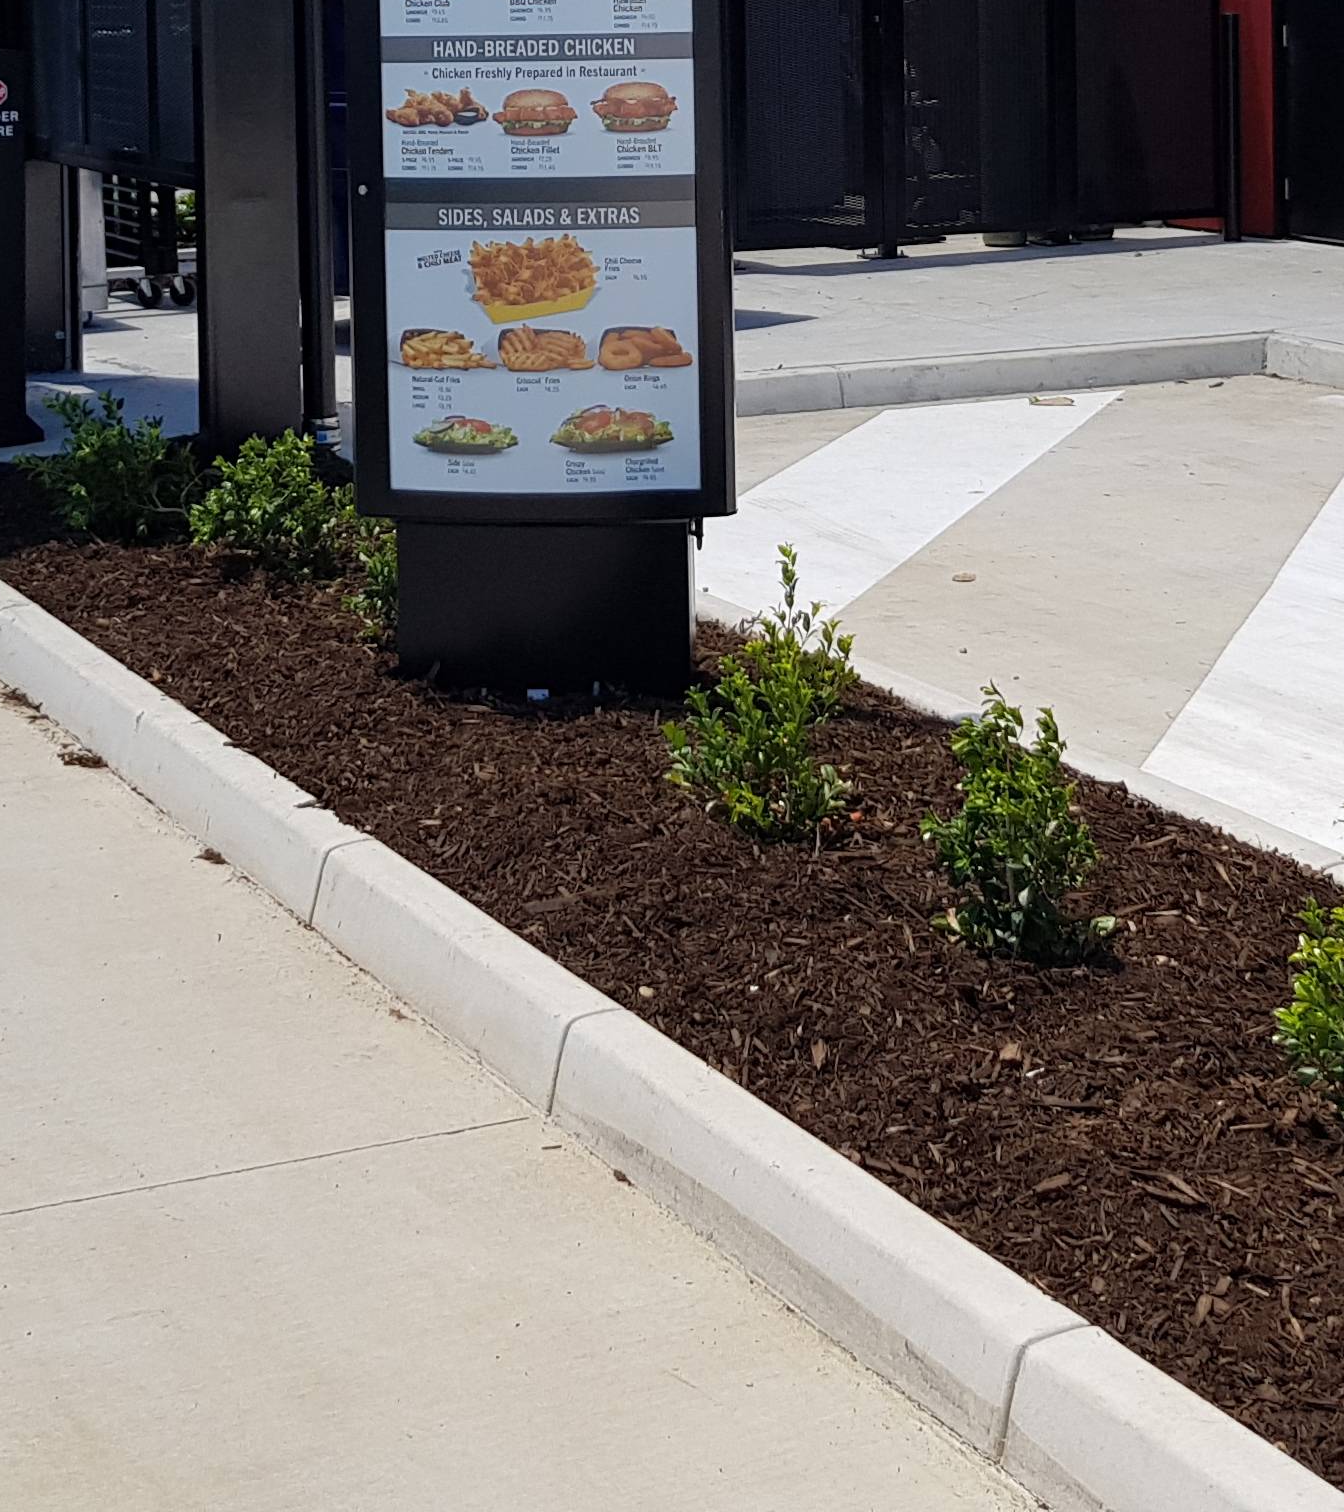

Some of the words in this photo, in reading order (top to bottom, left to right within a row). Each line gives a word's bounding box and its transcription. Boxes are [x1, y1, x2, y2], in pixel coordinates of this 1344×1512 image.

[433, 38, 559, 58] HAND-BREADED
[564, 38, 635, 56] CHICKEN
[431, 67, 472, 79] Chicken
[475, 67, 512, 80] Freshly
[515, 66, 563, 80] Prepared
[566, 66, 576, 78] in
[579, 65, 638, 78] Restaurant
[438, 208, 488, 228] SIDES,
[492, 208, 555, 225] SALADS
[559, 208, 572, 225] &
[577, 207, 640, 225] EXTRAS
